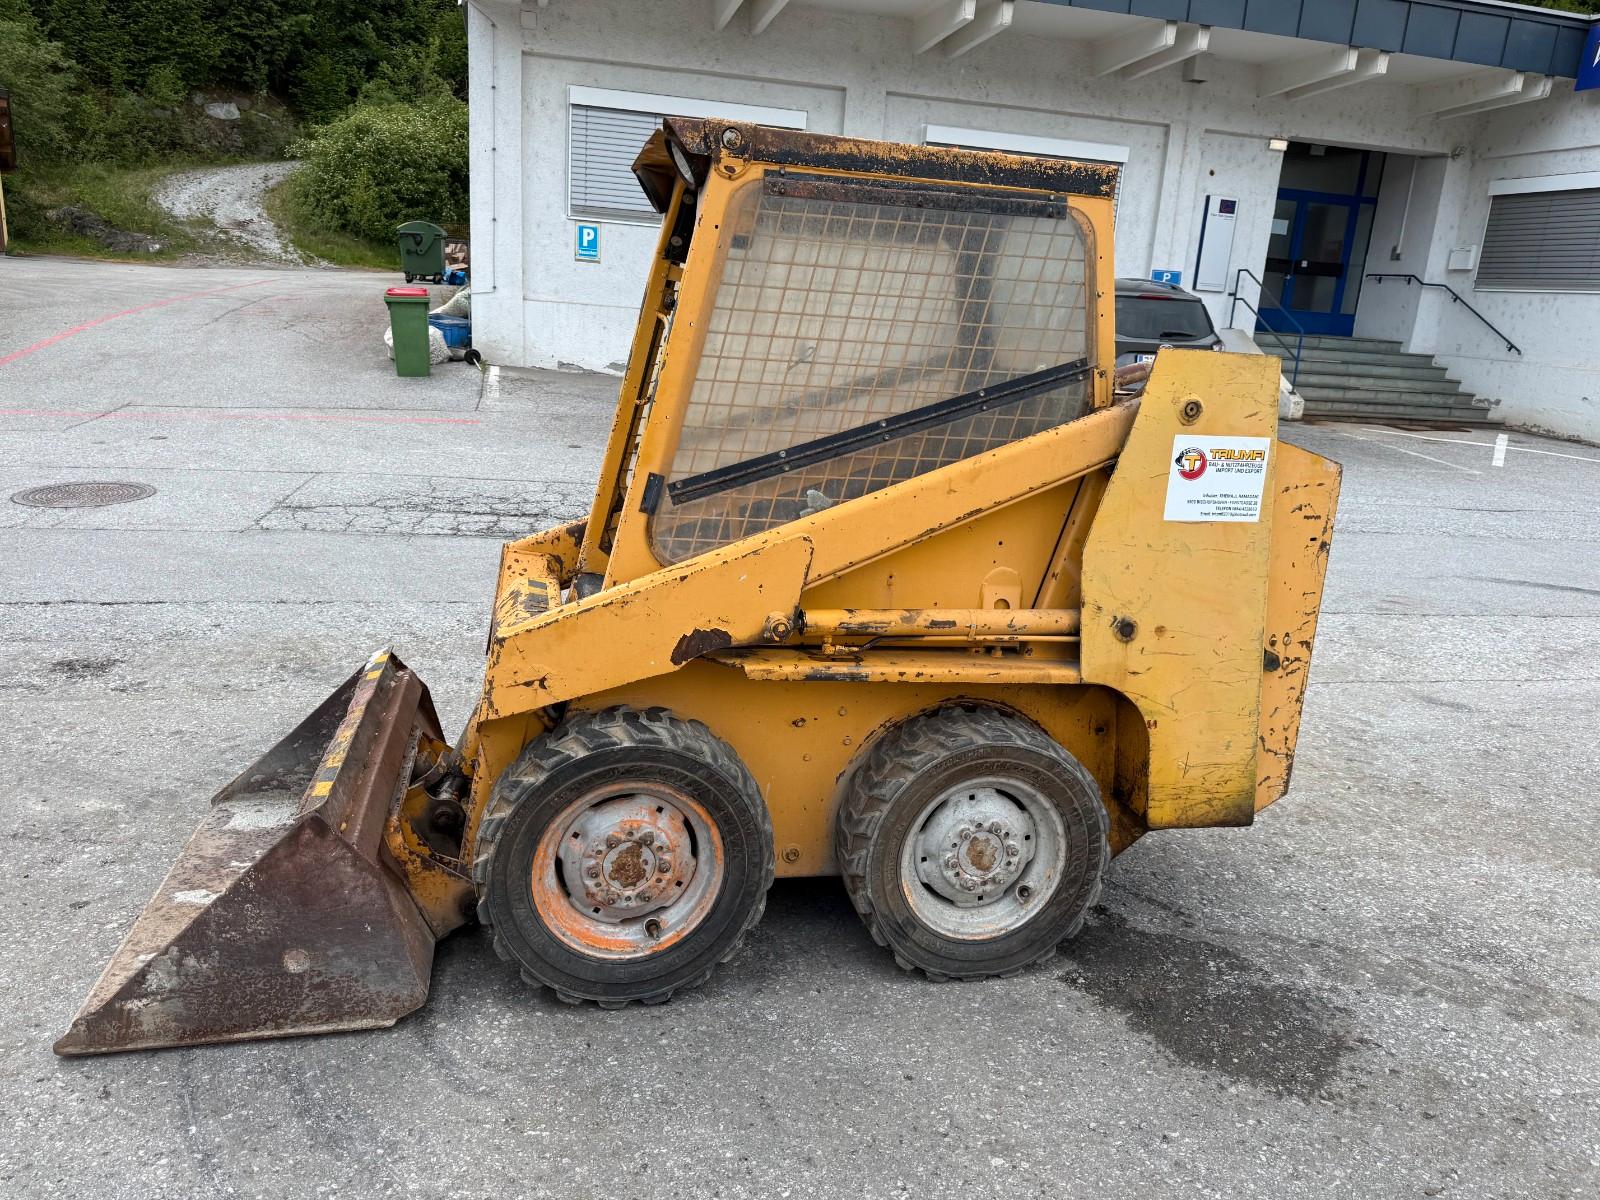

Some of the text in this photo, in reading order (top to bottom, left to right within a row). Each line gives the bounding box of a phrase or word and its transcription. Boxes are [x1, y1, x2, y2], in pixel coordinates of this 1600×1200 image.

[582, 228, 594, 247] P
[1163, 272, 1171, 282] P
[1185, 455, 1201, 472] T
